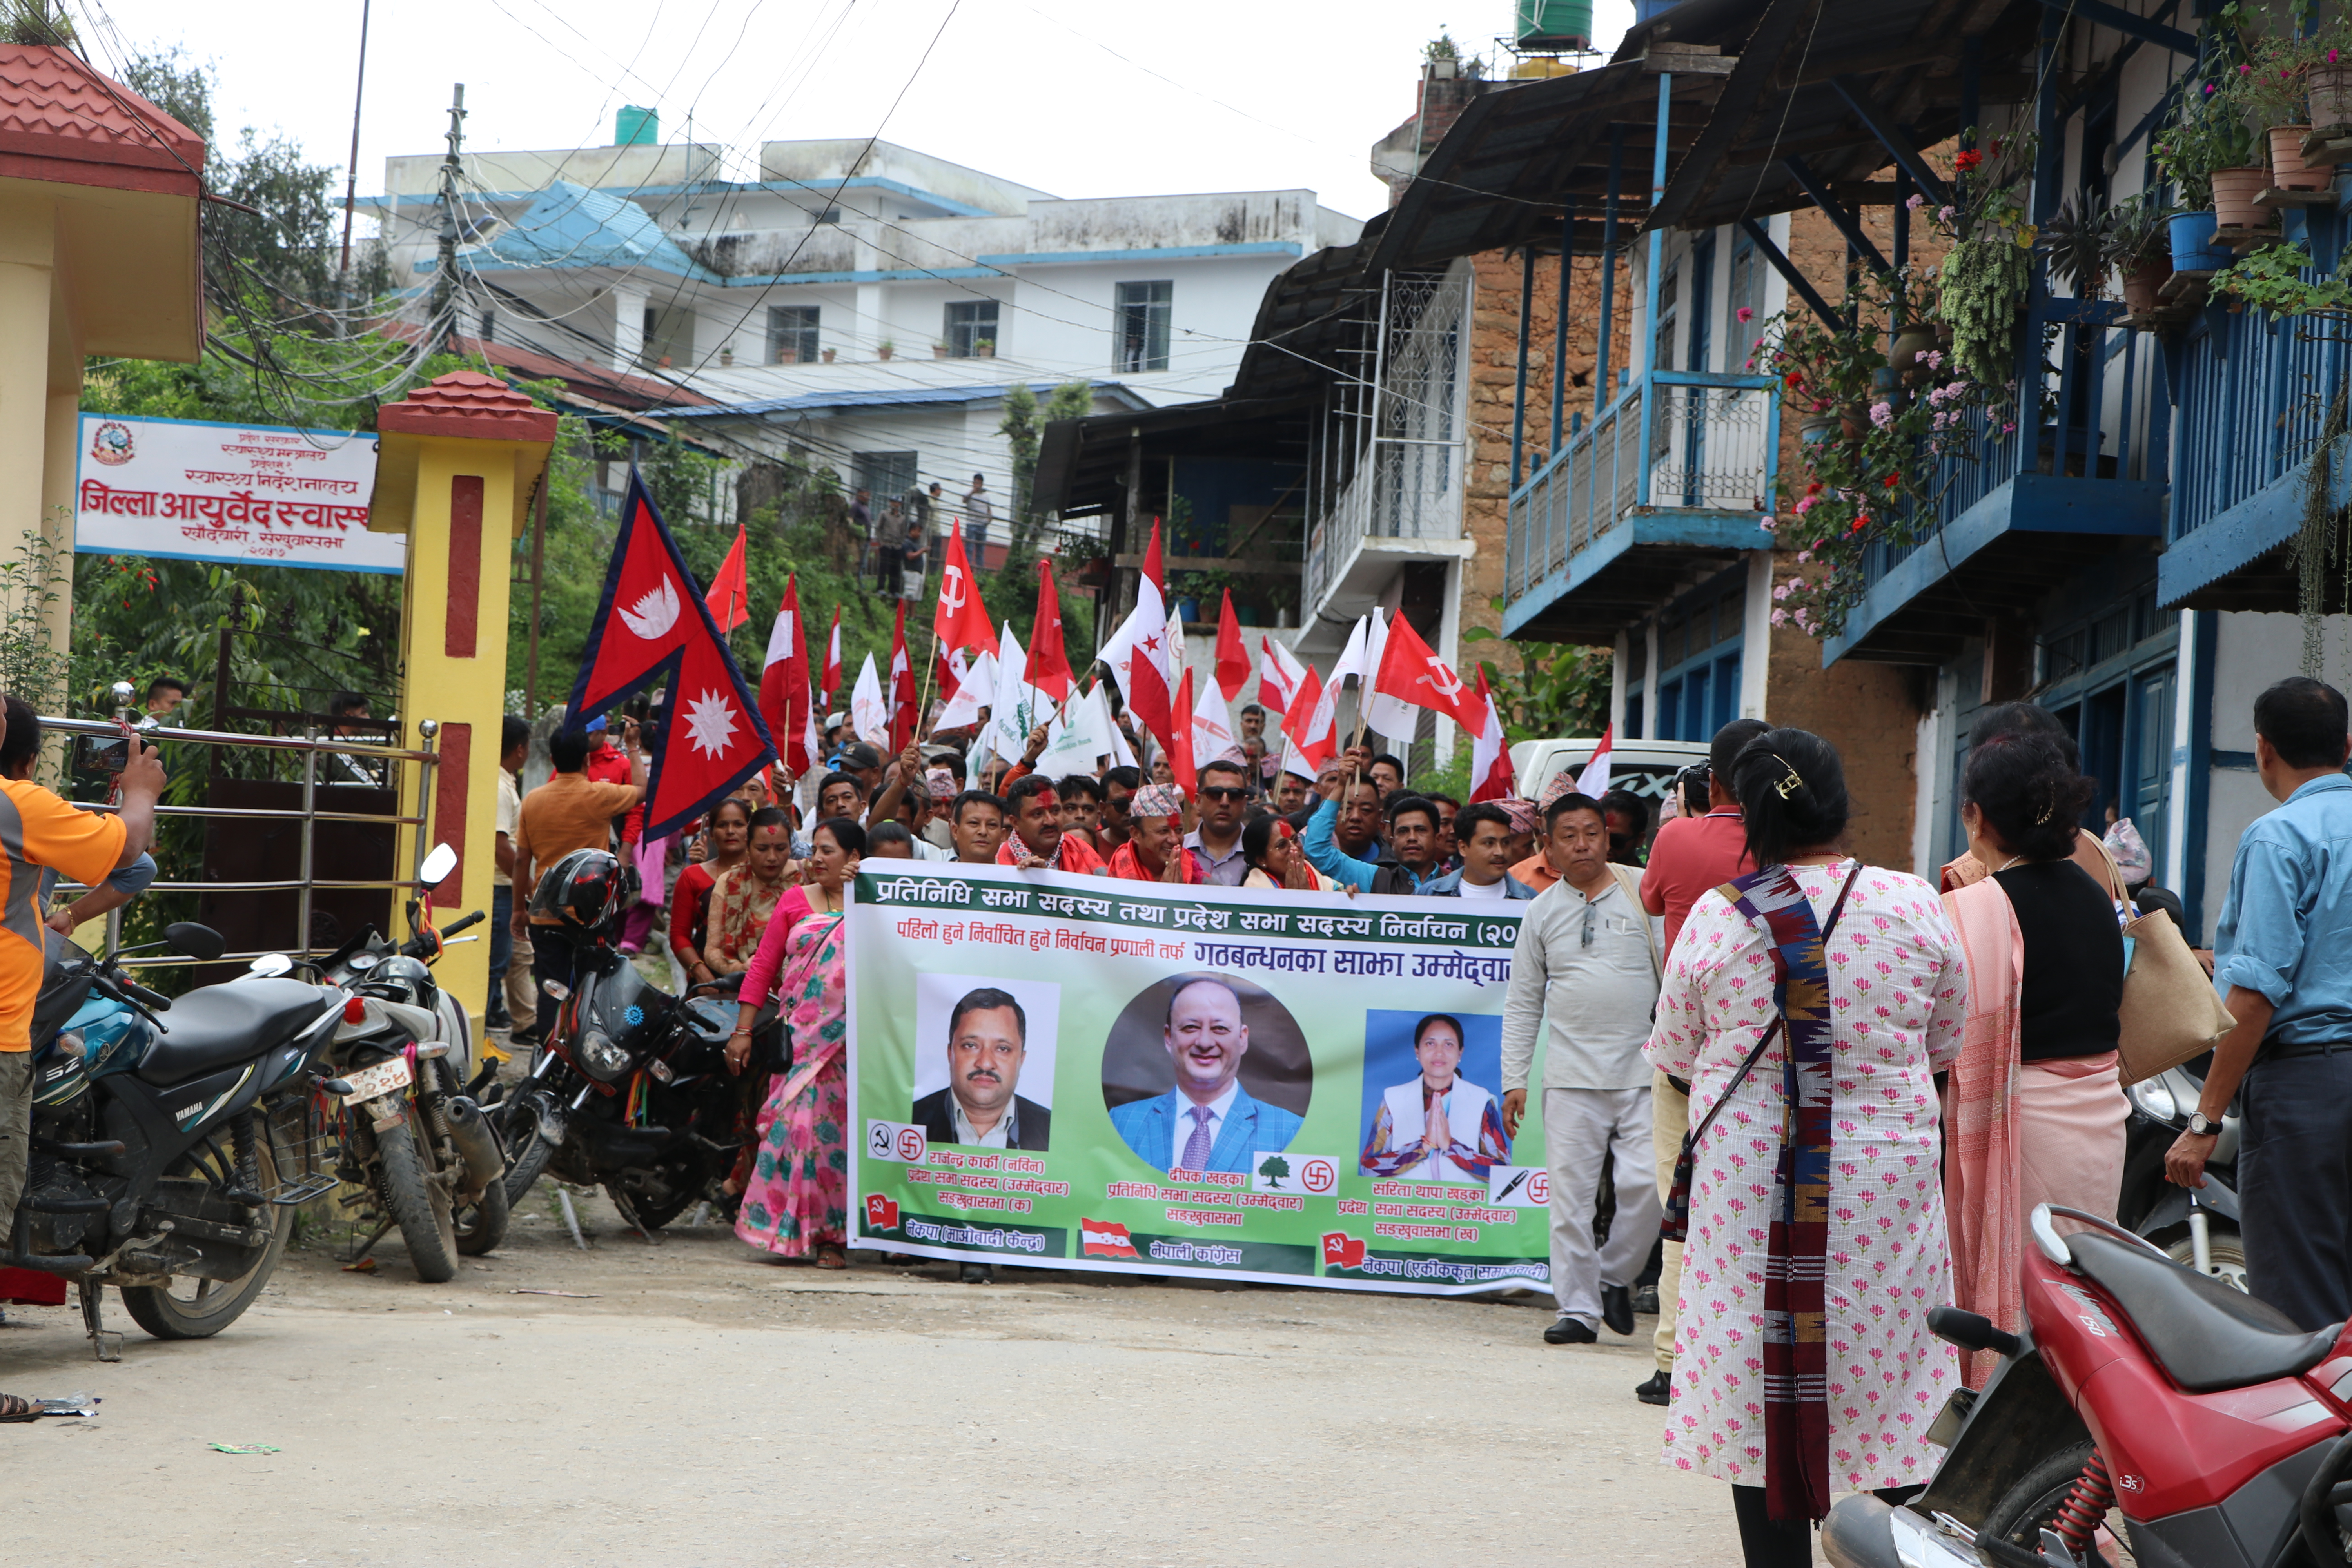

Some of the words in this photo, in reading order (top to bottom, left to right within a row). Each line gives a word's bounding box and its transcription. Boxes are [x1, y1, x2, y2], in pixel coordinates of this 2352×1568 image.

[264, 435, 303, 447] सरकार
[185, 470, 254, 487] स्वास्थ्य
[257, 470, 359, 495] निर्देशनालय
[81, 479, 158, 517] जिल्ला
[160, 490, 273, 529] आयुर्वेद
[276, 501, 368, 532] स्वास्थ
[258, 530, 345, 550] संखुवासभा
[875, 877, 973, 904] प्रतिनिधि
[981, 887, 1031, 909] सभा
[1038, 892, 1112, 917] सदस्य
[1119, 902, 1167, 924] तथा
[1173, 904, 1232, 930] प्रदेश
[1239, 912, 1289, 931] सभा
[1296, 915, 1372, 938] सदस्य
[1379, 913, 1469, 940] निर्वाचन
[1477, 922, 1517, 946] (२०
[897, 918, 938, 939] पहिलो
[943, 921, 964, 944] हुने
[969, 922, 1025, 945] निर्वाचित
[1030, 929, 1051, 951] हुने
[1055, 929, 1106, 953] निर्वाचन
[1110, 938, 1155, 957] प्रणाली
[1160, 942, 1184, 960] तर्फ
[1194, 942, 1327, 973] गठबन्धनका
[1334, 950, 1405, 976] साझा
[45, 1056, 79, 1082] SZ
[175, 1101, 203, 1122] YAMAHA
[929, 1151, 965, 1168] राजेन्द्र
[968, 1154, 1000, 1170] कार्की
[1002, 1157, 1045, 1174] (नविन)
[907, 1167, 932, 1183] प्रदेश
[934, 1172, 958, 1186] सभा
[960, 1174, 999, 1190] सदस्य
[1169, 1168, 1203, 1185] दीपक
[1206, 1172, 1245, 1188] खड्का
[1107, 1181, 1159, 1199] प्रतिनिधि
[1161, 1187, 1189, 1202] सभा
[1192, 1190, 1232, 1205] सदस्य
[1373, 1181, 1412, 1198] सरिता
[1415, 1184, 1444, 1200] थापा
[1447, 1187, 1487, 1204] खड्का
[1008, 1198, 1033, 1214] (क)
[1337, 1198, 1369, 1215] प्रदेश
[1375, 1203, 1403, 1216] सभा
[1406, 1205, 1447, 1220] सदस्य
[905, 1218, 941, 1240] नेकपा
[1006, 1229, 1046, 1252] केन्द्र)
[1454, 1228, 1479, 1243] (ख)
[1149, 1241, 1193, 1262] नेपाली
[1195, 1245, 1242, 1265] कांग्रेस
[1362, 1255, 1403, 1276] नेकपा
[2078, 1315, 2106, 1337] 150
